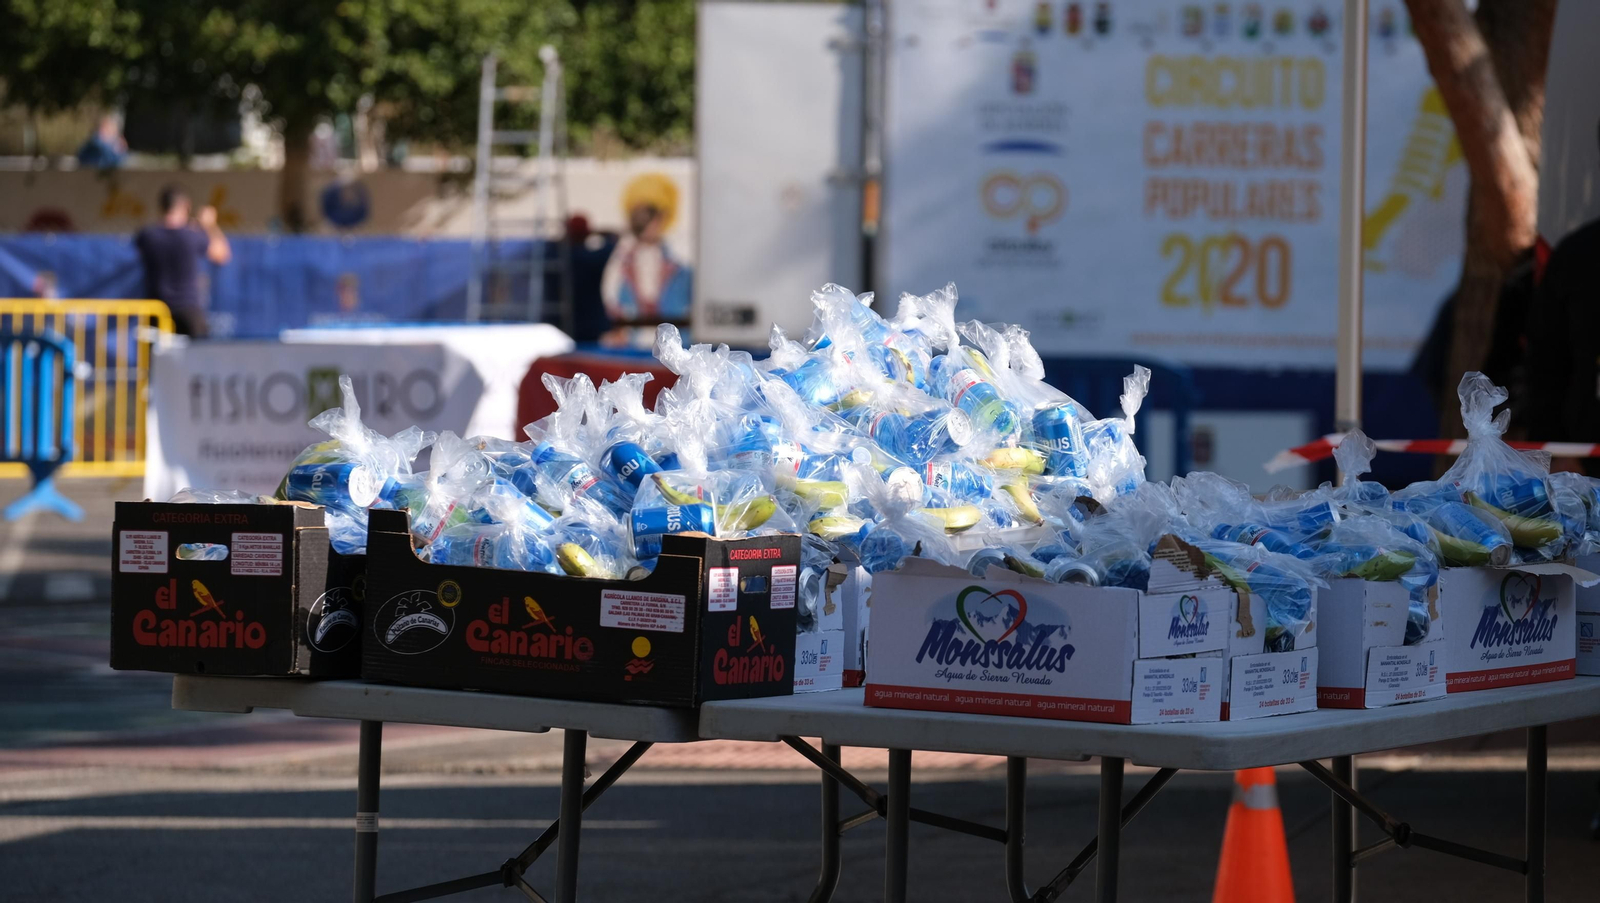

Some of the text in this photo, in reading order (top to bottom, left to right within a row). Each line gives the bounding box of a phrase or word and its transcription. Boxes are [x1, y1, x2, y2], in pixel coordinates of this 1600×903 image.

[1145, 55, 1325, 109] CIRCUITO
[1144, 121, 1324, 170] CARRERAS
[1144, 178, 1322, 222] POPULARES
[1161, 233, 1291, 309] 2020
[153, 512, 249, 524] CATEGORIA EXTRA
[730, 548, 781, 560] CATEGORIA EXTRA
[155, 578, 177, 609] el
[417, 616, 439, 628] Canarias
[488, 597, 509, 624] el
[133, 609, 266, 649] Canario
[466, 619, 595, 660] Canario
[728, 615, 741, 647] el
[1168, 616, 1209, 639] Monssalus
[1470, 604, 1558, 649] Monssalus
[915, 620, 1075, 673] Monssalus
[1480, 645, 1544, 663] Agua de Sierra Nevada
[714, 644, 784, 685] Canario
[935, 669, 1053, 686] Agua de Sierra Nevada
[1454, 676, 1470, 684] mineral
[1471, 675, 1485, 683] natural
[1514, 670, 1528, 678] natural
[1531, 670, 1541, 678] agua
[1557, 664, 1570, 673] natural
[874, 689, 1115, 713] agua mineral natural agua mineral natural agua mineral natural
[1323, 692, 1350, 700] natural
